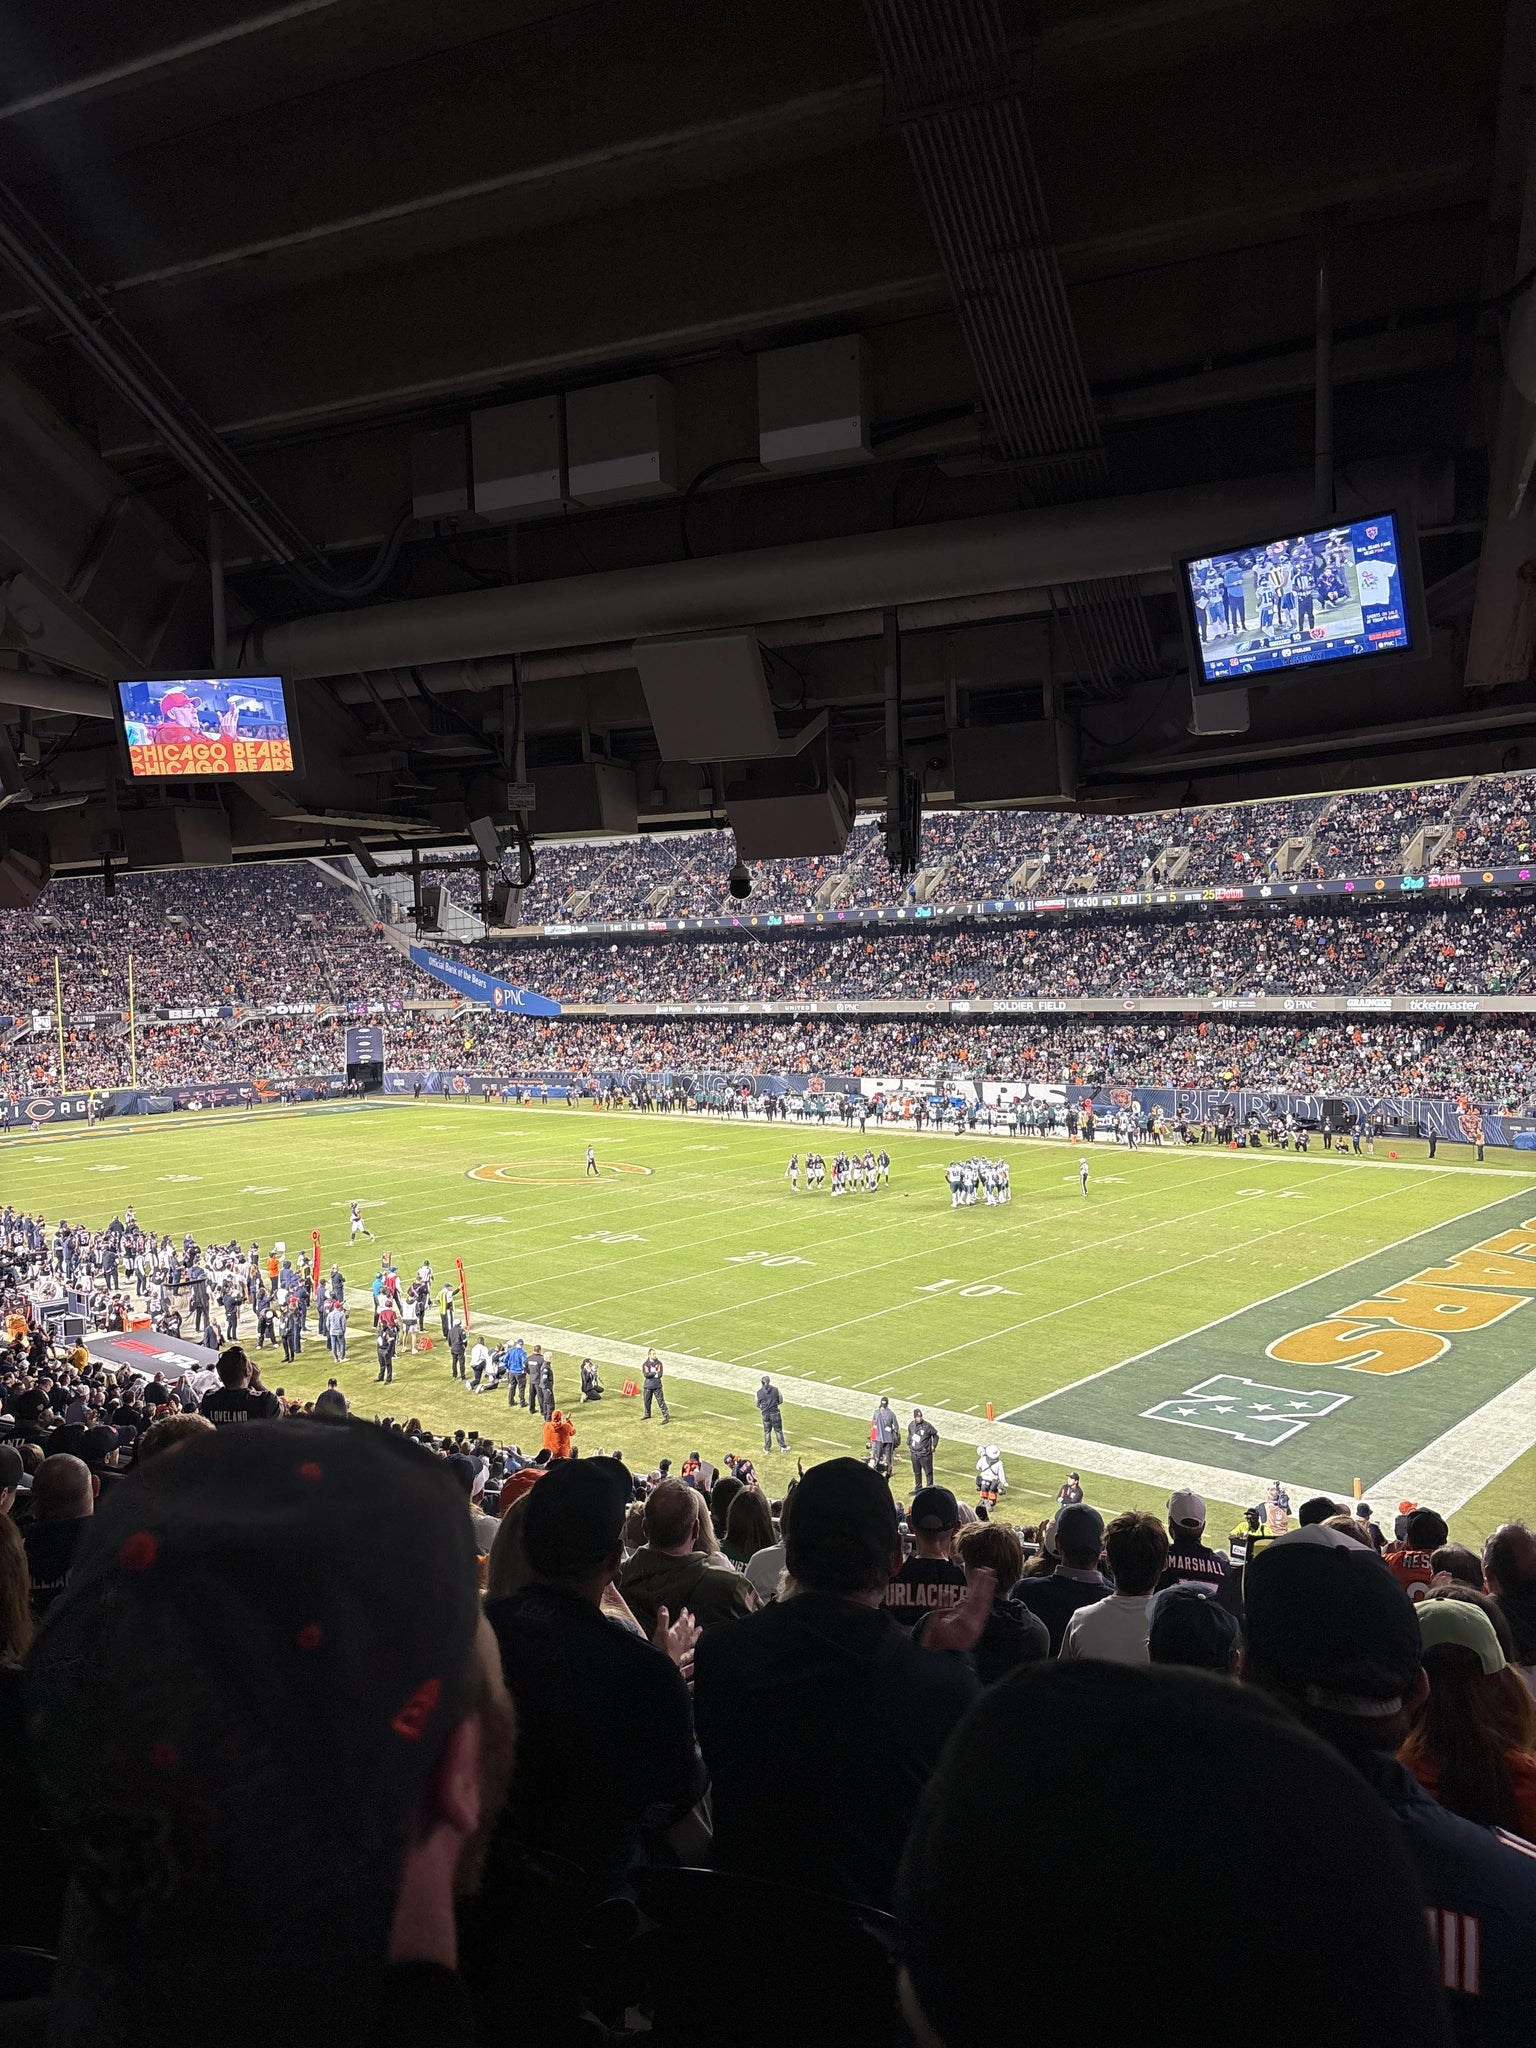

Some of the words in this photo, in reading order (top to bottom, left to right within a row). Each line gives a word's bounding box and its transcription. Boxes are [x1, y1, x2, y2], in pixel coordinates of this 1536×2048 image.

[130, 743, 227, 762] CHICAGO
[232, 739, 292, 758] BEARS
[132, 759, 230, 775] CHICAGO
[1073, 897, 1098, 908] 14:00
[1111, 895, 1119, 905] 3
[1145, 893, 1152, 903] 3
[1169, 891, 1177, 901] 5
[1202, 889, 1215, 900] 25
[966, 904, 973, 914] 7
[1014, 901, 1026, 911] 10
[428, 956, 445, 970] Official
[444, 961, 458, 976] Bank
[457, 967, 463, 977] of
[463, 969, 472, 982] the
[471, 973, 487, 989] Bears
[504, 989, 526, 1006] PNC
[1346, 999, 1392, 1007] GRAINGER
[265, 1004, 316, 1015] DOWN
[844, 1003, 860, 1011] PNC
[993, 1002, 1034, 1011] SOLDIER
[1038, 1002, 1066, 1011] FIELD
[1295, 1001, 1317, 1009] PNC
[1410, 999, 1479, 1010] ticketmaster
[168, 1009, 220, 1019] BEAR
[723, 1250, 802, 1267] 20
[914, 1278, 1003, 1298] 10
[149, 1301, 161, 1311] 65
[151, 1351, 200, 1369] NFL
[210, 1410, 248, 1422] LOVELAND
[1168, 1555, 1226, 1577] MARSHALL
